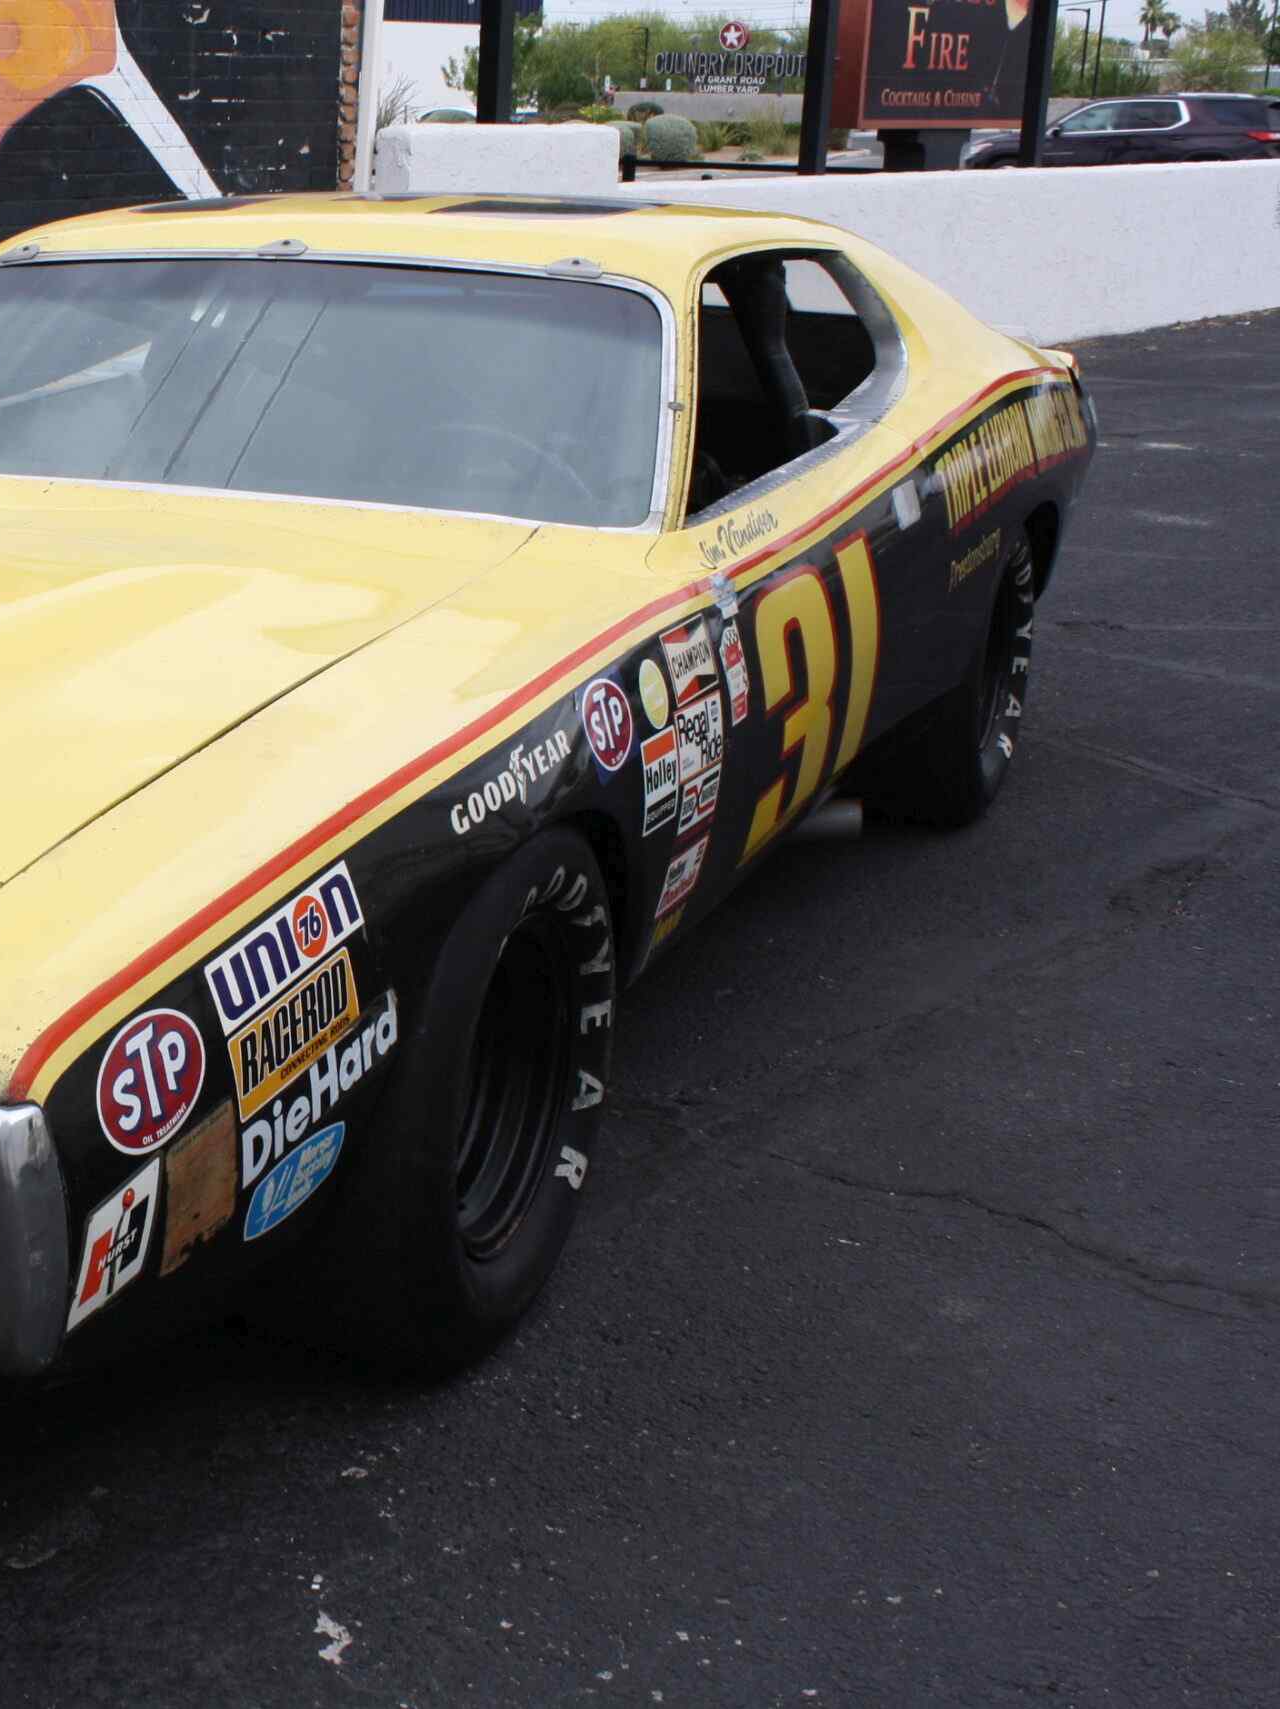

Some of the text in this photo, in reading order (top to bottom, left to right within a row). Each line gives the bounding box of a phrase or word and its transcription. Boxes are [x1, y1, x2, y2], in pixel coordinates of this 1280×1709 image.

[655, 51, 804, 78] CULINARY DROPOUT
[694, 75, 766, 85] AT GRANT ROAD
[698, 84, 760, 94] LUMBER YARD
[671, 640, 712, 679] CHAMPION
[590, 687, 624, 752] STP
[738, 530, 881, 868] 31
[677, 700, 710, 747] Regal
[700, 730, 722, 769] Ride
[645, 758, 677, 795] Holley
[298, 902, 323, 950] 76
[240, 955, 351, 1097] RACEROD
[112, 1022, 186, 1131] STP
[241, 997, 399, 1189] DieHard
[142, 1101, 188, 1146] OIL TREATMENT
[97, 1227, 138, 1272] HURST
